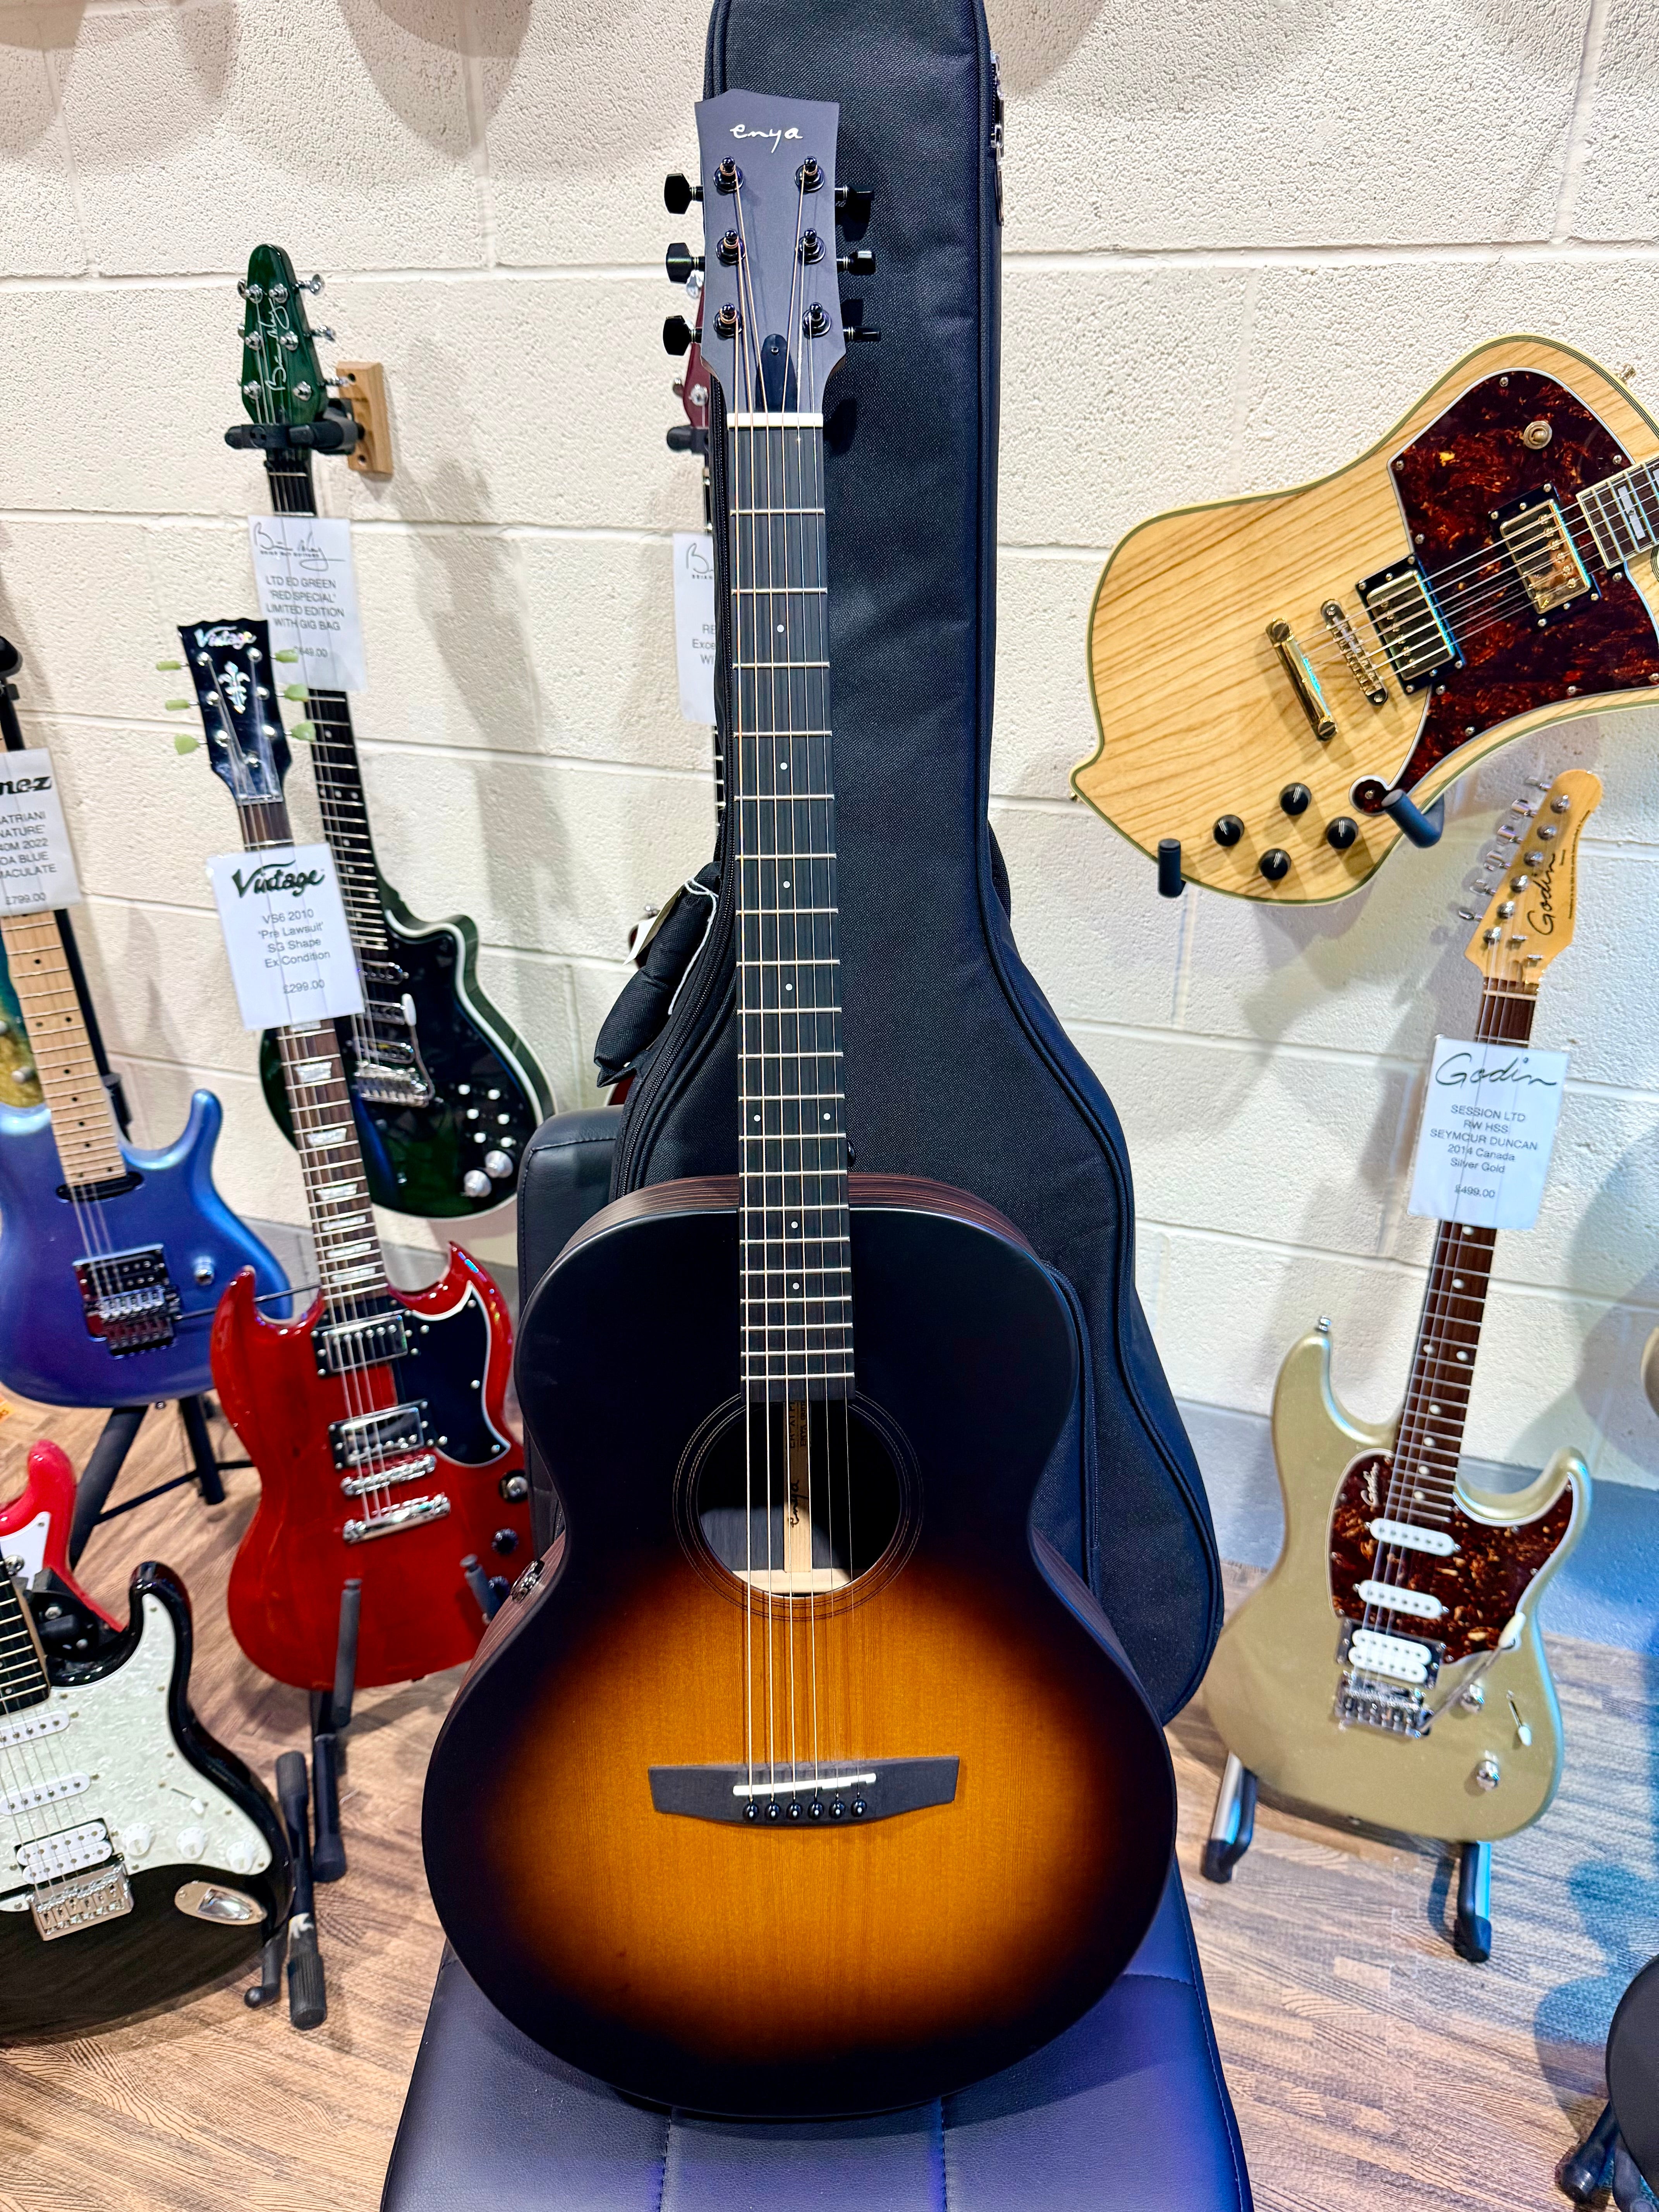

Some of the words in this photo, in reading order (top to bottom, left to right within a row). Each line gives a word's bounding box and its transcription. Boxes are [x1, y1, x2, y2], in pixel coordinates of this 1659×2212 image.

[730, 124, 803, 153] enya
[266, 575, 284, 586] LTD
[286, 576, 300, 587] ED
[301, 577, 336, 589] GREEN
[266, 604, 302, 615] LIMITED
[304, 606, 345, 617] EDITION
[274, 618, 298, 628] WITH
[300, 619, 317, 630] GIG
[319, 620, 341, 631] BAG
[22, 837, 49, 849] 2022
[18, 852, 50, 864] BLUE
[232, 860, 325, 898] Vintage
[1527, 853, 1556, 935] Godin
[262, 912, 285, 924] VS6
[288, 908, 314, 921] 2010
[267, 942, 285, 953] SG
[287, 937, 321, 951] Shape
[264, 957, 280, 969] Ex
[280, 950, 331, 966] Condition
[283, 979, 325, 994] £299.00
[1436, 1052, 1558, 1089] Godin
[1451, 1104, 1501, 1120] SESSION
[1504, 1112, 1526, 1122] LTD
[1464, 1119, 1482, 1130] RW
[1485, 1123, 1509, 1134] HSS
[1430, 1128, 1487, 1144] SEYMOUR
[1490, 1136, 1538, 1151] DUNCAN
[1448, 1144, 1473, 1155] 2014
[1475, 1147, 1515, 1161] Canada
[1450, 1157, 1478, 1170] Silver
[1481, 1161, 1506, 1174] Gold
